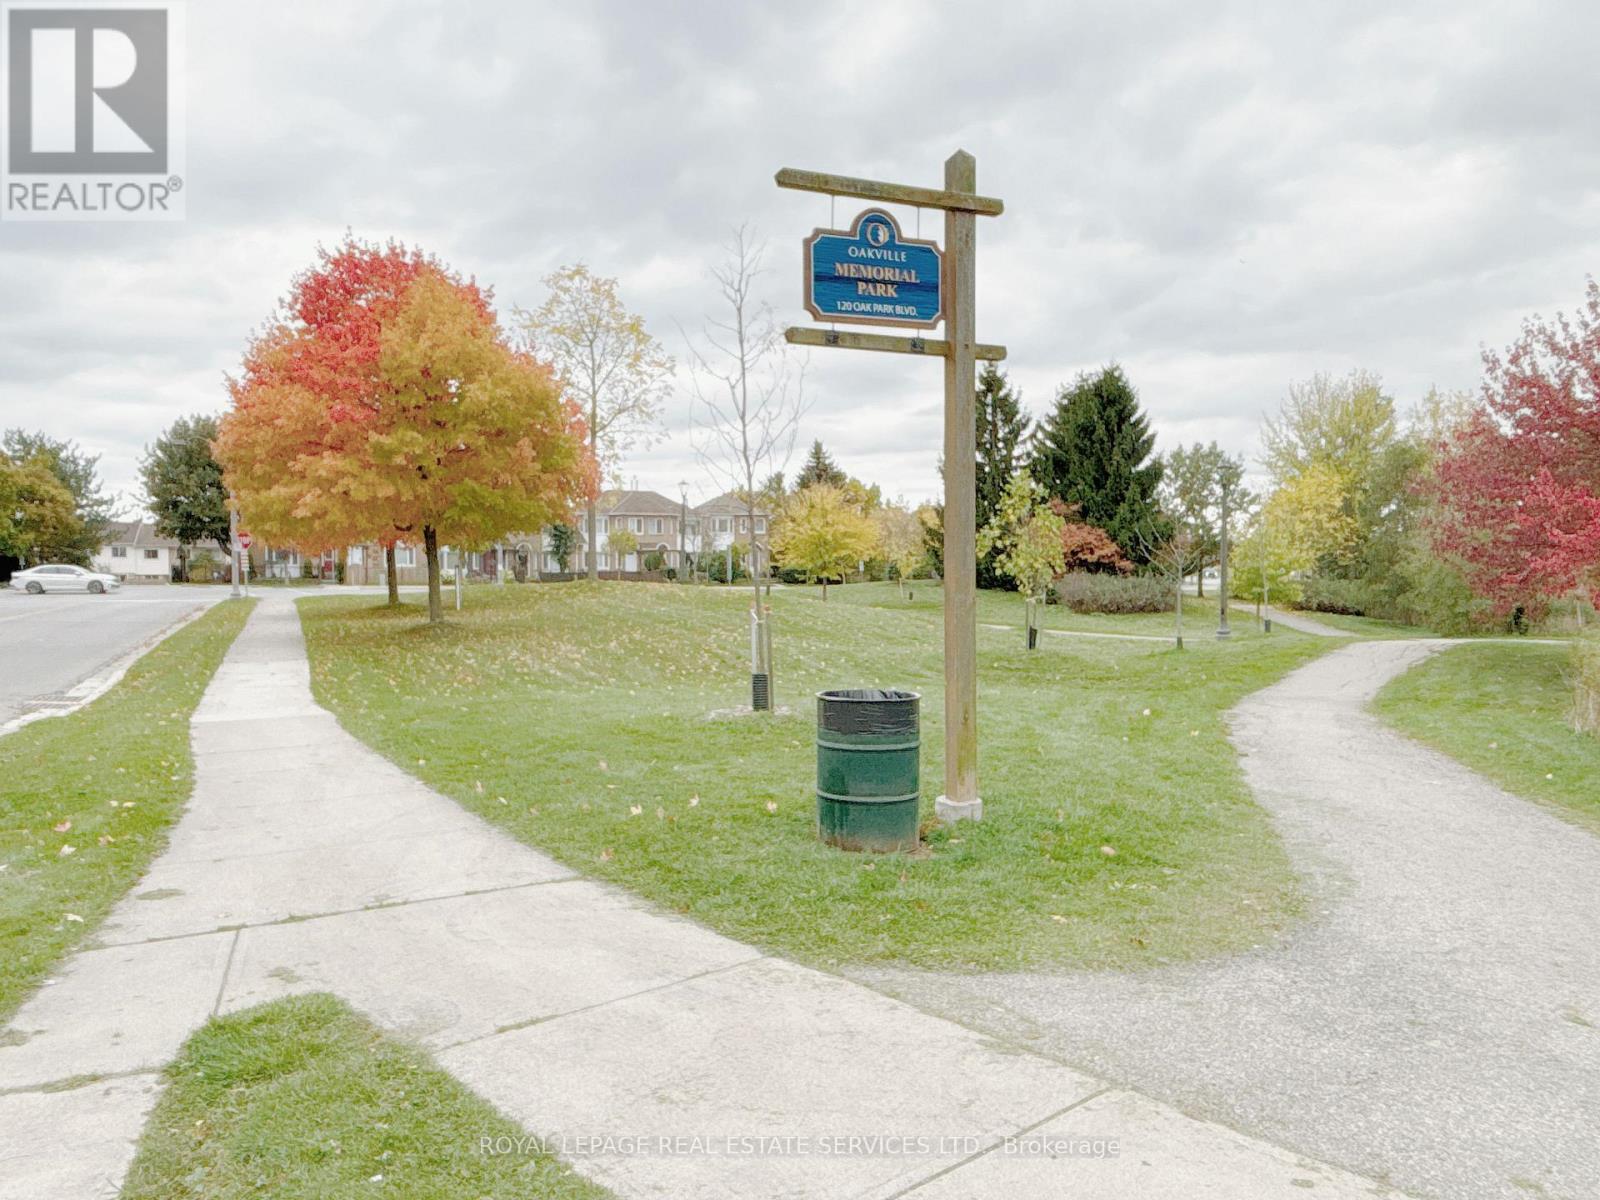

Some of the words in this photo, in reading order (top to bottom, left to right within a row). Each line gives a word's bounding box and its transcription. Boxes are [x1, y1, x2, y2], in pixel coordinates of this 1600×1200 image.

[848, 246, 907, 262] OAKVILLE
[834, 262, 920, 283] MEMORIAL
[857, 281, 898, 298] PARK
[837, 301, 852, 311] 120
[853, 301, 872, 312] OAK
[873, 303, 894, 314] PARK
[895, 305, 919, 317] BLVD.
